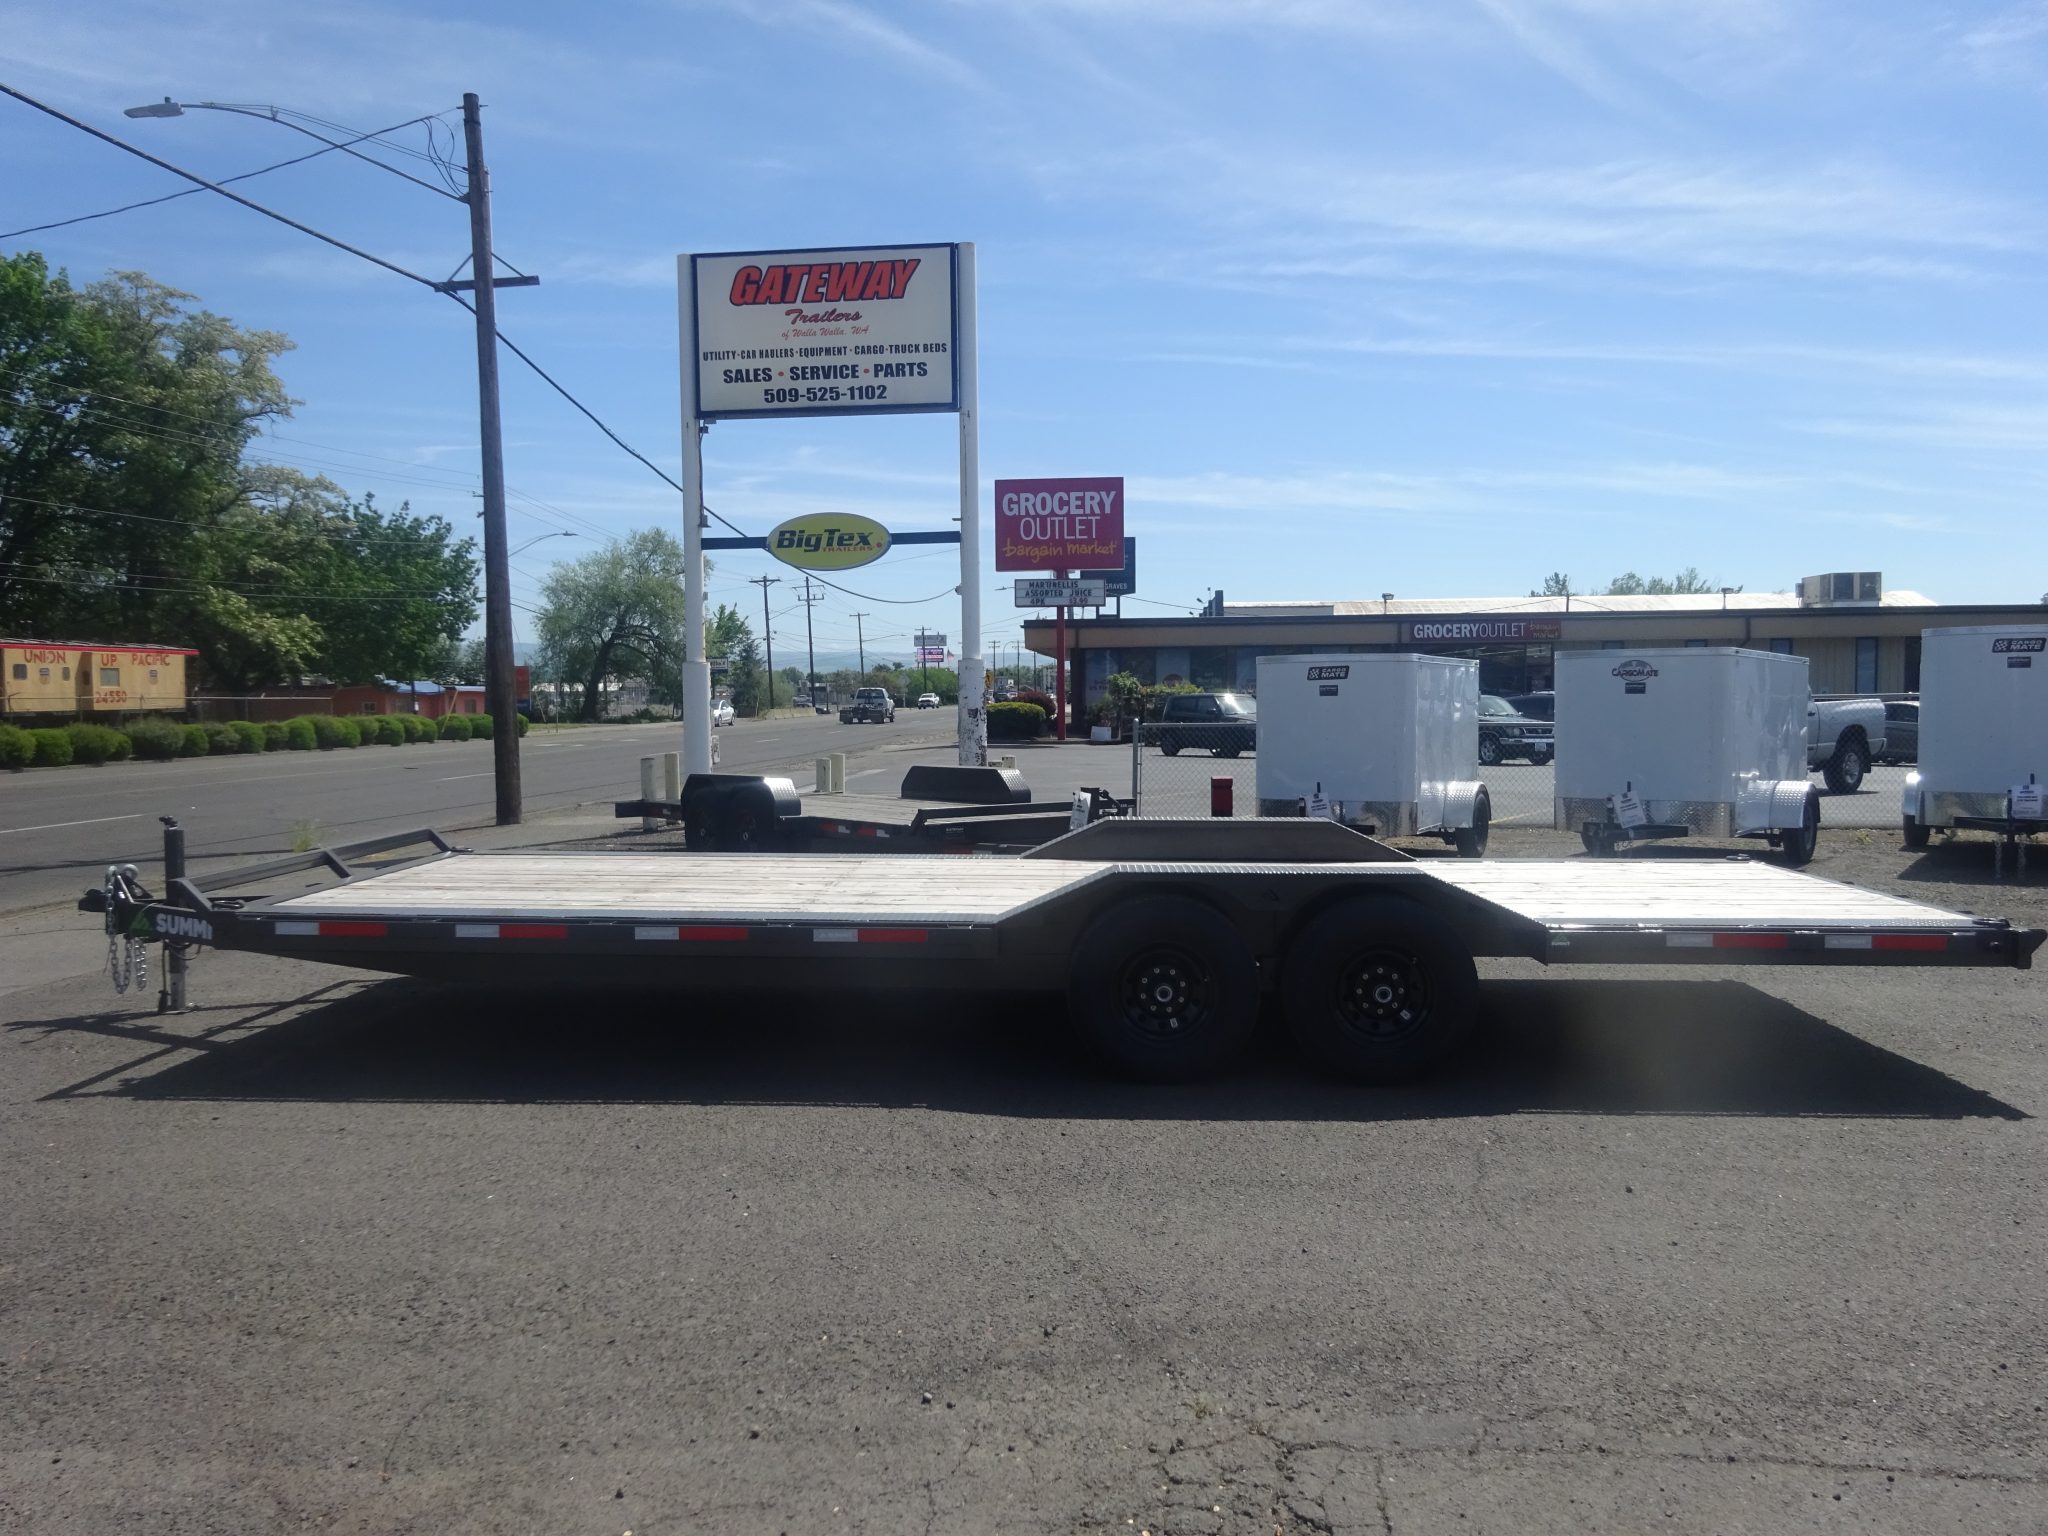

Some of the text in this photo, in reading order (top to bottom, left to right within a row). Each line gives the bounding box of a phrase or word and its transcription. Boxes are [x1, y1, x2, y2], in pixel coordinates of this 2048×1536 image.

[729, 259, 921, 306] GATEWAY
[785, 308, 862, 325] Trailers
[781, 330, 789, 341] of
[792, 328, 817, 338] Walla
[851, 325, 870, 335] WA
[703, 342, 947, 361] UTILITY CAR HAULERS EQUIPMENT CARGO TRUCK BEDS
[723, 361, 928, 384] SALES SERVICE PARTS
[763, 384, 888, 404] 509-525-1102
[1002, 490, 1117, 516] GROCERY
[1020, 516, 1100, 541] OUTLET
[1002, 537, 1117, 564] bargain market
[1025, 588, 1093, 597] ASSORTED JUICE
[1029, 581, 1079, 589] MARTINELLIS
[24, 649, 171, 667] UNION UP PACIFIC
[156, 913, 213, 940] SUMMI
